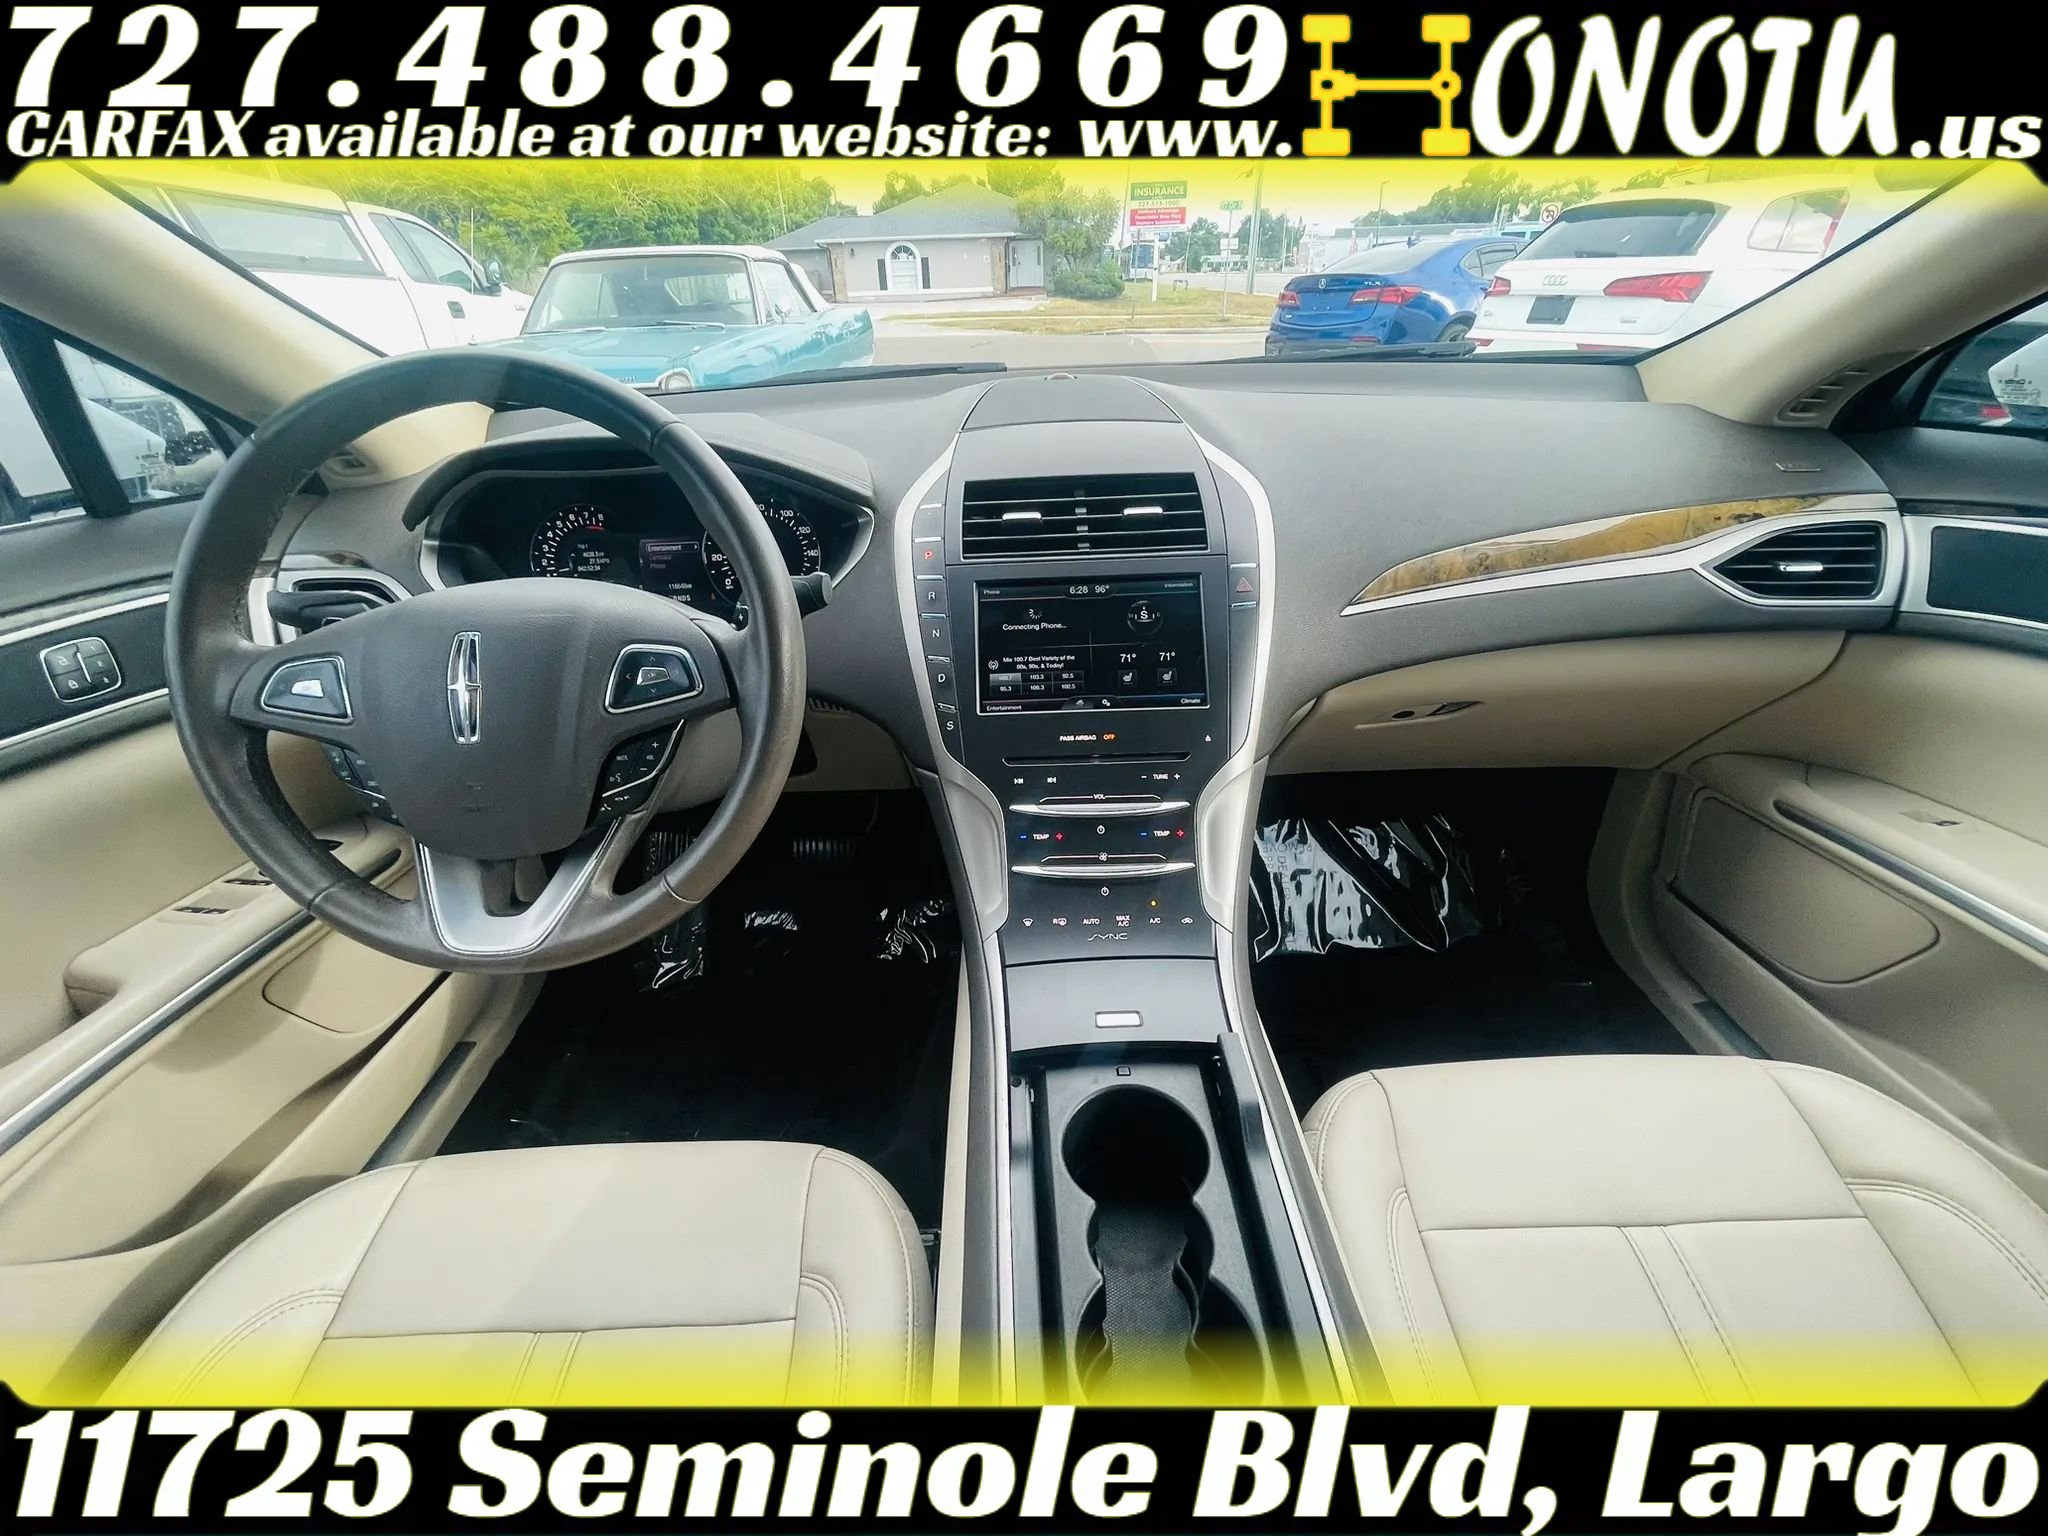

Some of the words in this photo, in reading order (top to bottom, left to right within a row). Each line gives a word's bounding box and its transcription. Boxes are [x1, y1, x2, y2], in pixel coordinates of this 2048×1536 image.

[1134, 186, 1185, 197] INSURANCE
[924, 551, 932, 560] P
[1069, 586, 1089, 595] 6:28
[928, 591, 936, 600] R
[1140, 611, 1149, 620] S
[1002, 623, 1040, 632] Connecting
[932, 629, 940, 638] N
[1041, 655, 1060, 663] Variety
[938, 674, 946, 683] D
[946, 721, 954, 730] S
[1087, 932, 1129, 941] SYNC
